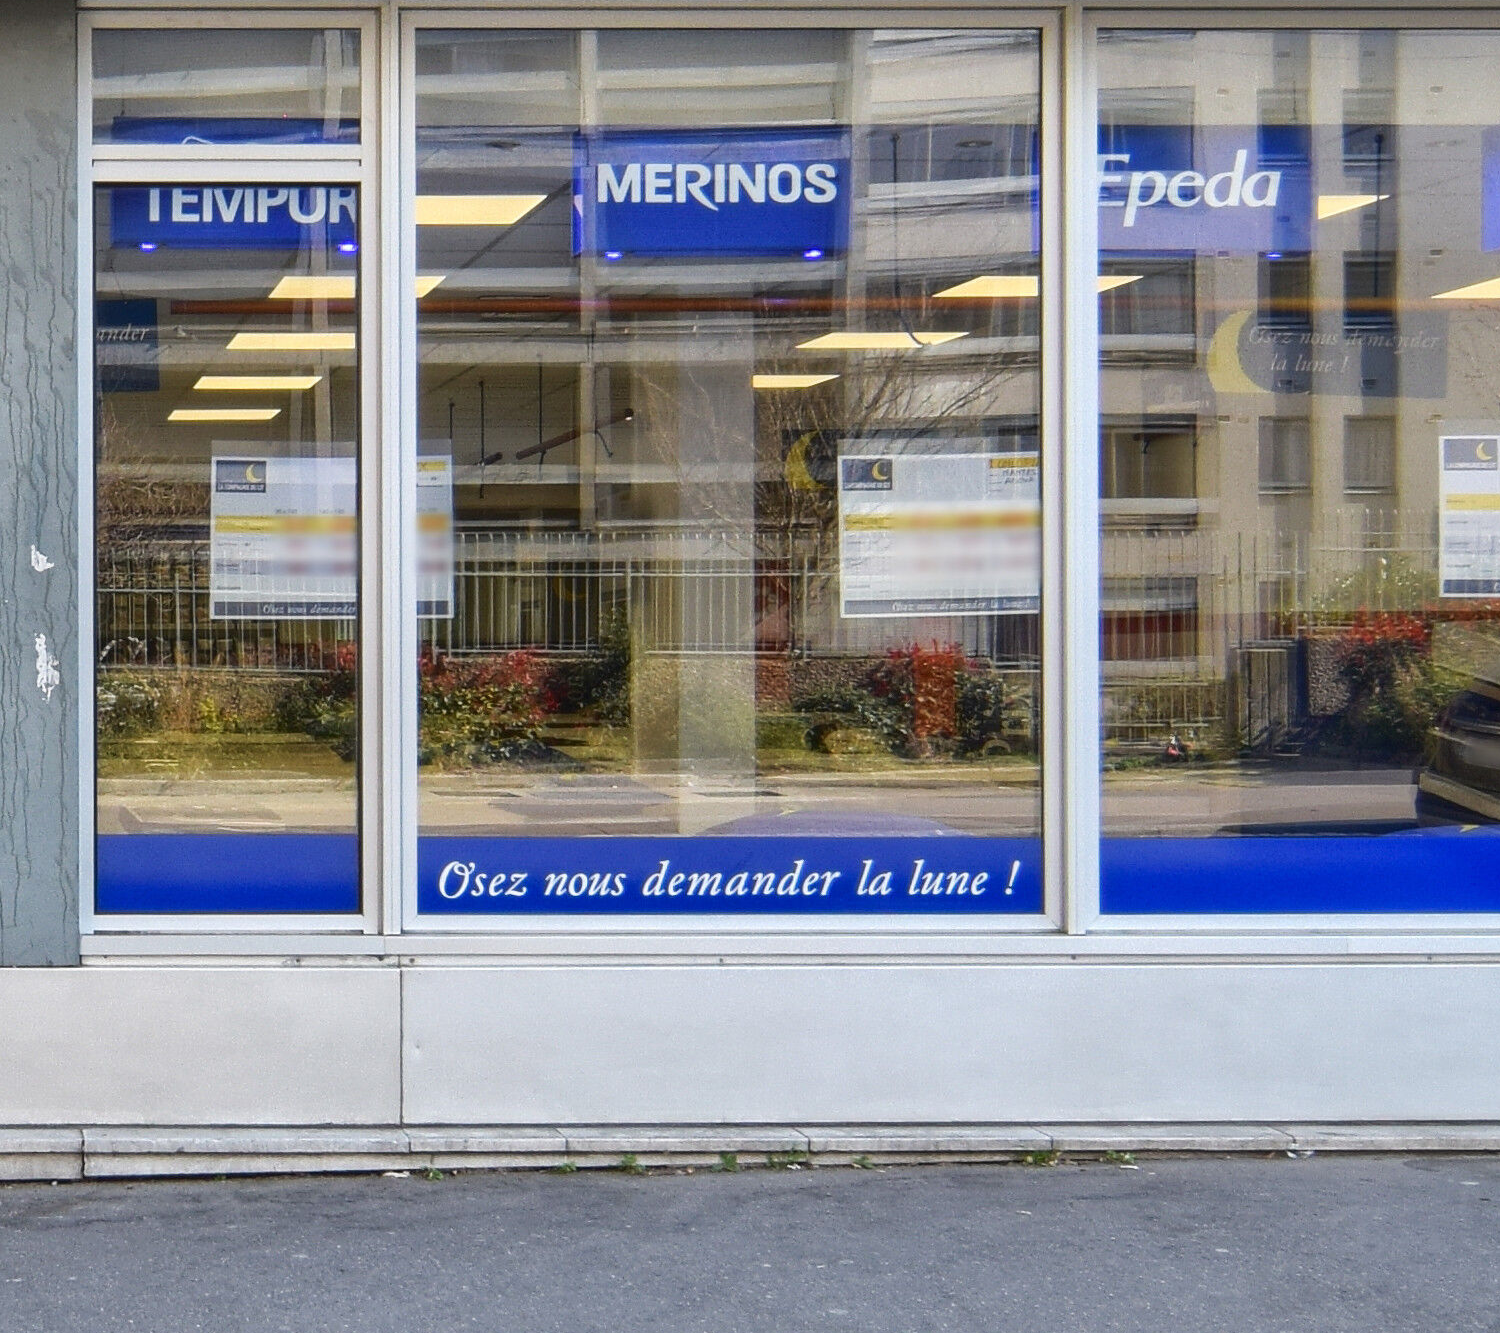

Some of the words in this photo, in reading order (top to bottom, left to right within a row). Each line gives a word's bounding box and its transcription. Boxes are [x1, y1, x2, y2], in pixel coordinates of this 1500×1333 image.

[597, 163, 838, 212] MERINOS
[1097, 149, 1282, 228] Epeda
[1299, 331, 1339, 346] nous
[438, 860, 528, 899] Osez
[545, 872, 627, 897] nous
[642, 858, 841, 897] demander
[857, 859, 892, 896] la
[909, 858, 989, 896] lune
[1005, 859, 1021, 895] !
